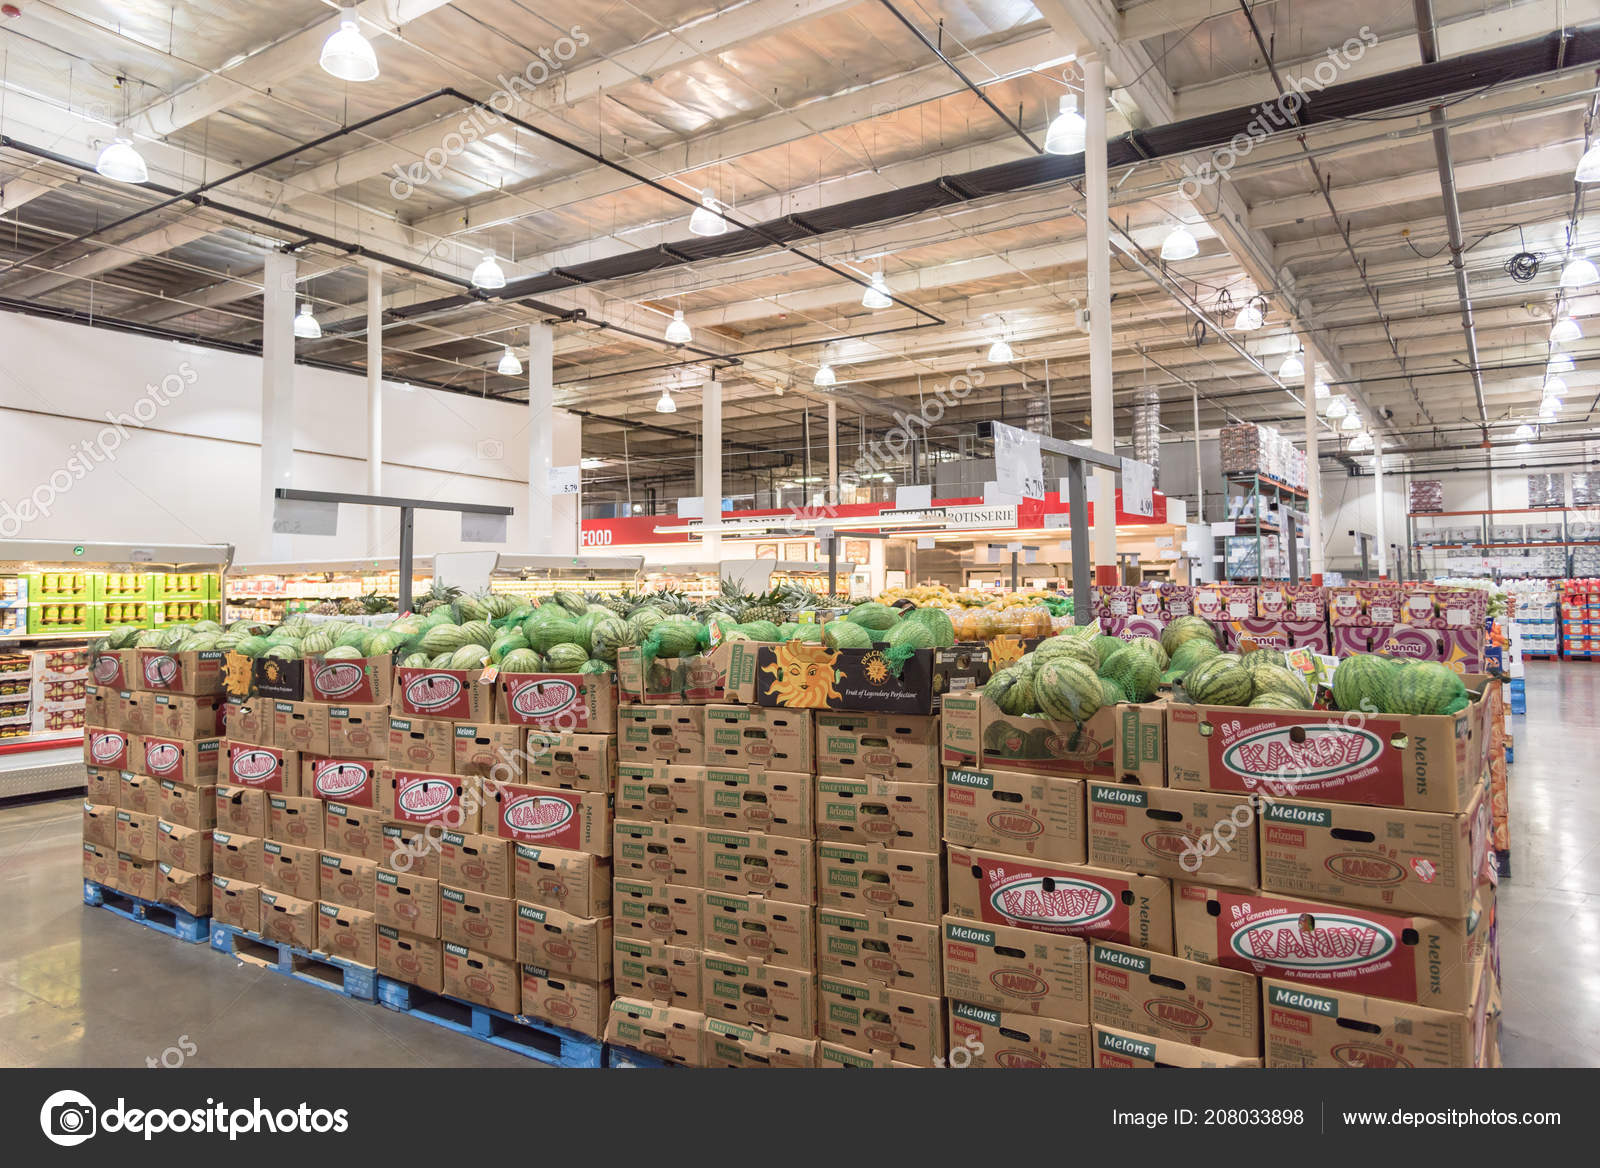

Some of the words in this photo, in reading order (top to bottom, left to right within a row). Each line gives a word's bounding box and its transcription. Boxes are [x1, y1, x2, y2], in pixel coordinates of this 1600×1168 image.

[564, 484, 578, 493] 5.79
[1025, 478, 1043, 497] 5.79
[1140, 499, 1153, 515] 4.99
[581, 529, 612, 546] FOOD
[518, 685, 569, 712] KANDY
[864, 690, 890, 699] Legendary
[1236, 722, 1277, 738] Generations
[1239, 734, 1365, 773] KANDY
[1414, 735, 1426, 796] Melons
[952, 771, 989, 786] Melons
[1286, 781, 1320, 791] American
[1321, 778, 1345, 789] Family
[1345, 766, 1380, 783] Tradition
[1097, 788, 1143, 804] Melons
[511, 803, 566, 826] KANDY
[1095, 808, 1124, 822] Arizona
[1271, 806, 1325, 822] Melons
[1269, 828, 1303, 842] Arizona
[1001, 872, 1033, 885] Generations
[1003, 889, 1100, 917] KANDY
[520, 907, 544, 920] Melons
[1140, 897, 1150, 949] Melons
[1230, 919, 1246, 930] Four
[1246, 907, 1287, 923] Generations
[952, 927, 991, 943] Melons
[1248, 927, 1378, 960] KANDY
[1100, 948, 1145, 969] Melons
[1428, 934, 1441, 995] Melons
[1284, 970, 1295, 978] An
[1296, 970, 1331, 980] American
[1332, 969, 1357, 980] Family
[1357, 960, 1392, 975] Tradition
[1275, 990, 1331, 1013] Melons
[957, 1003, 997, 1022] Melons
[1273, 1012, 1309, 1030] Arizona
[1104, 1035, 1150, 1057] Melons
